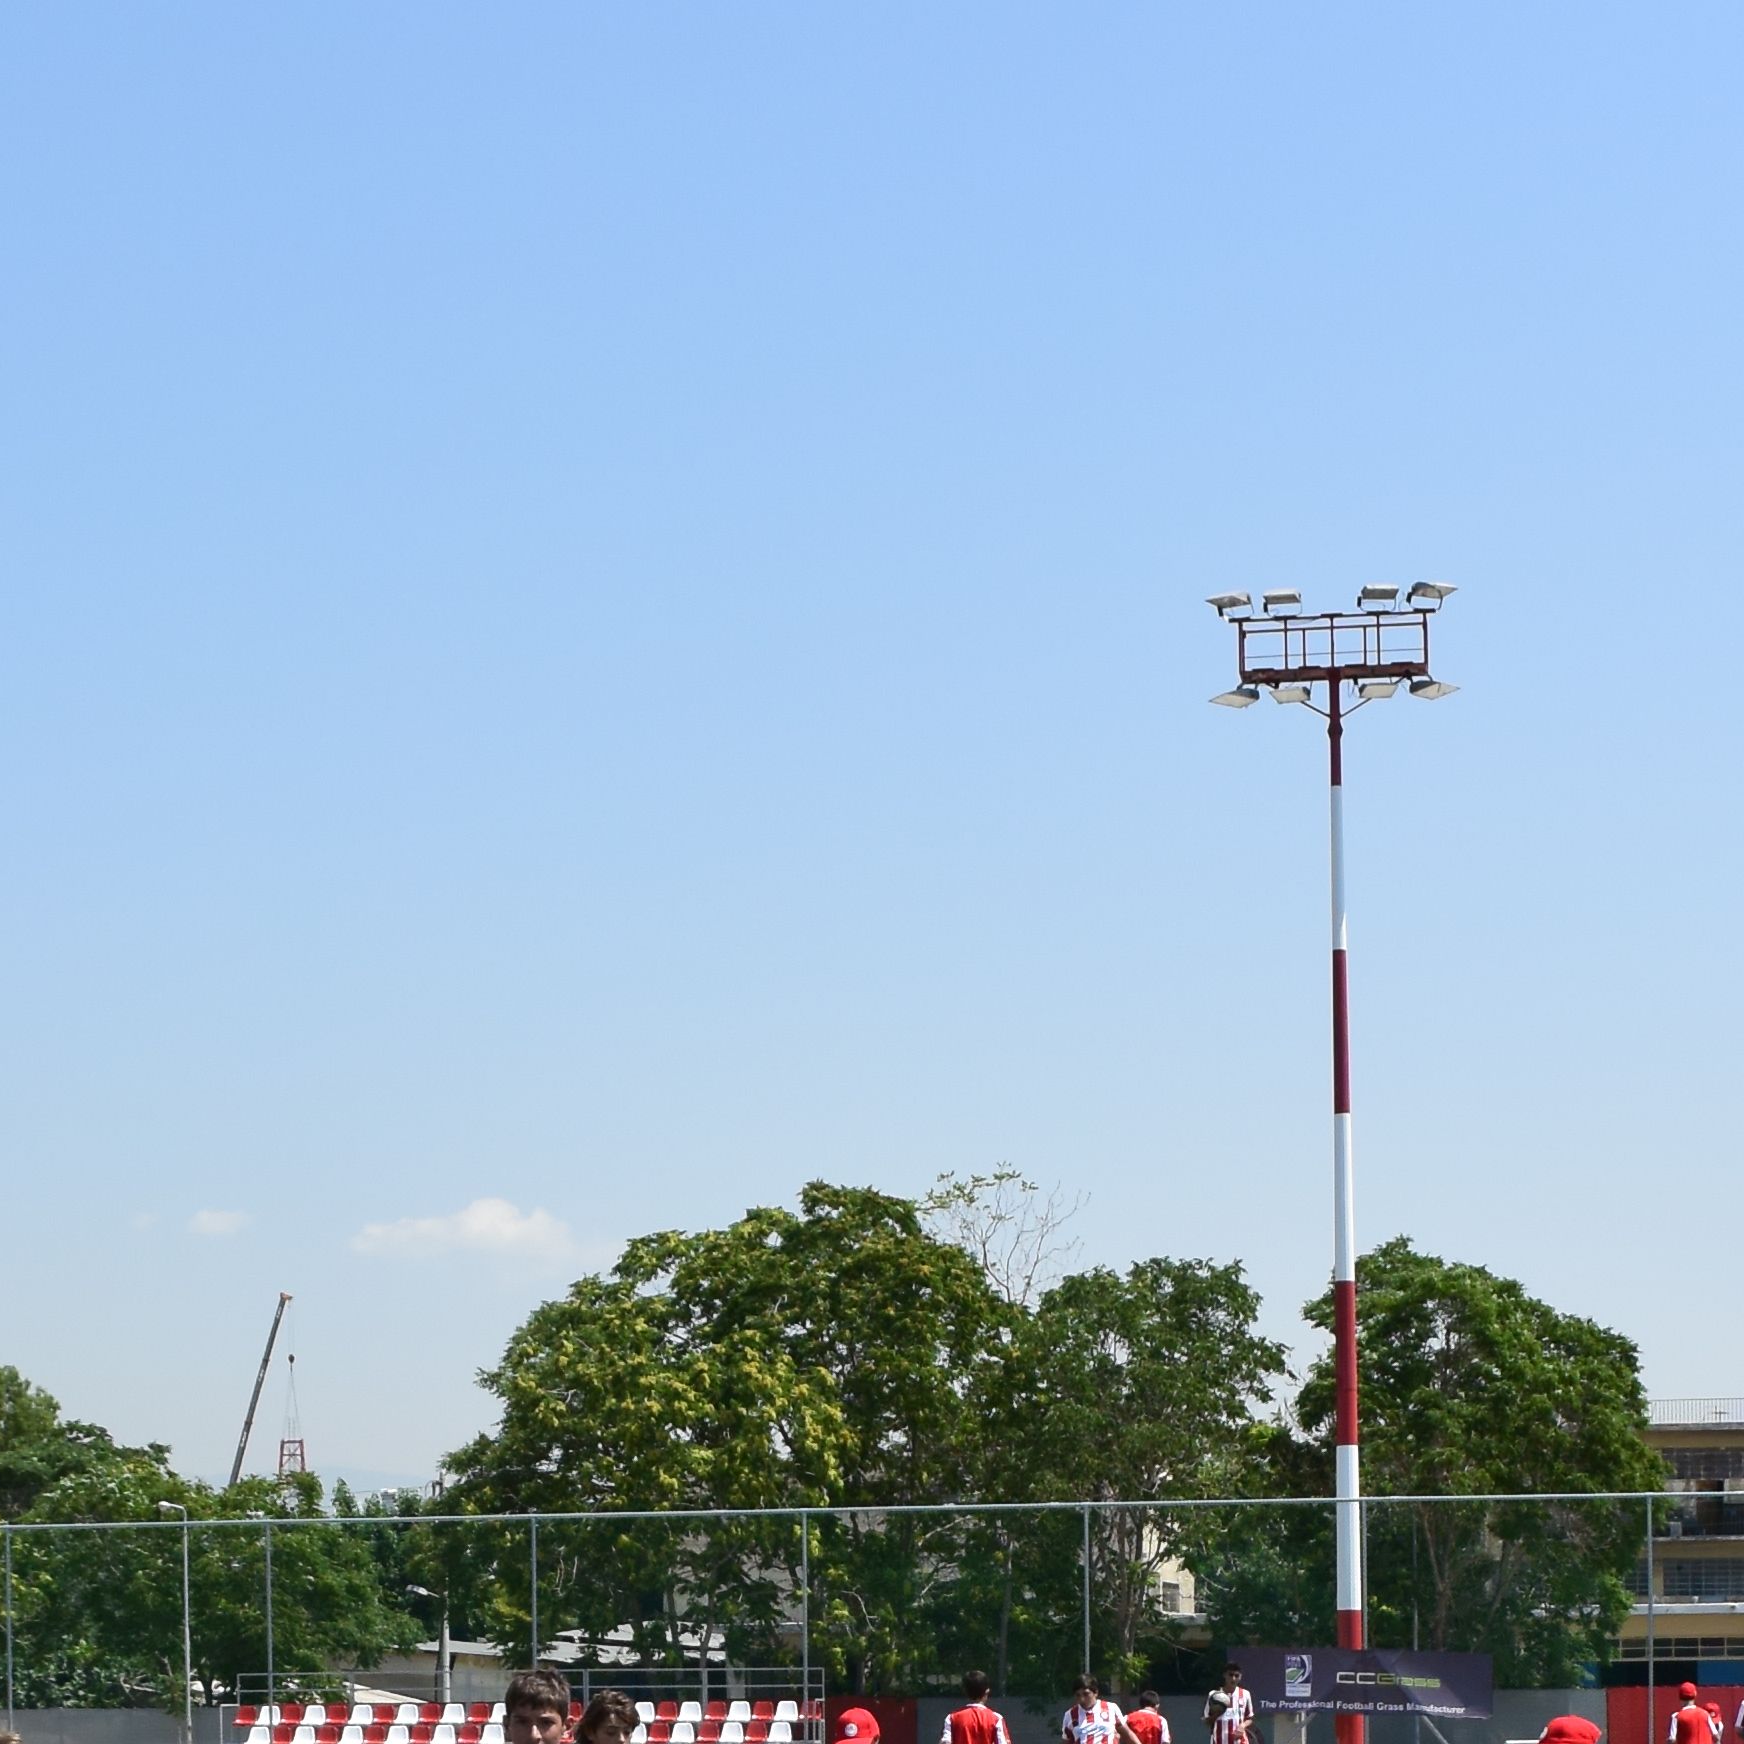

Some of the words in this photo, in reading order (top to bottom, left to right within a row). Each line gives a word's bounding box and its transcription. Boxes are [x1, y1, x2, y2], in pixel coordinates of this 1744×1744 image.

[1261, 1700, 1277, 1709] The
[1279, 1700, 1334, 1709] Professional
[1336, 1701, 1374, 1711] Football
[1376, 1702, 1404, 1711] Grass
[1406, 1702, 1466, 1714] Manufacturer
